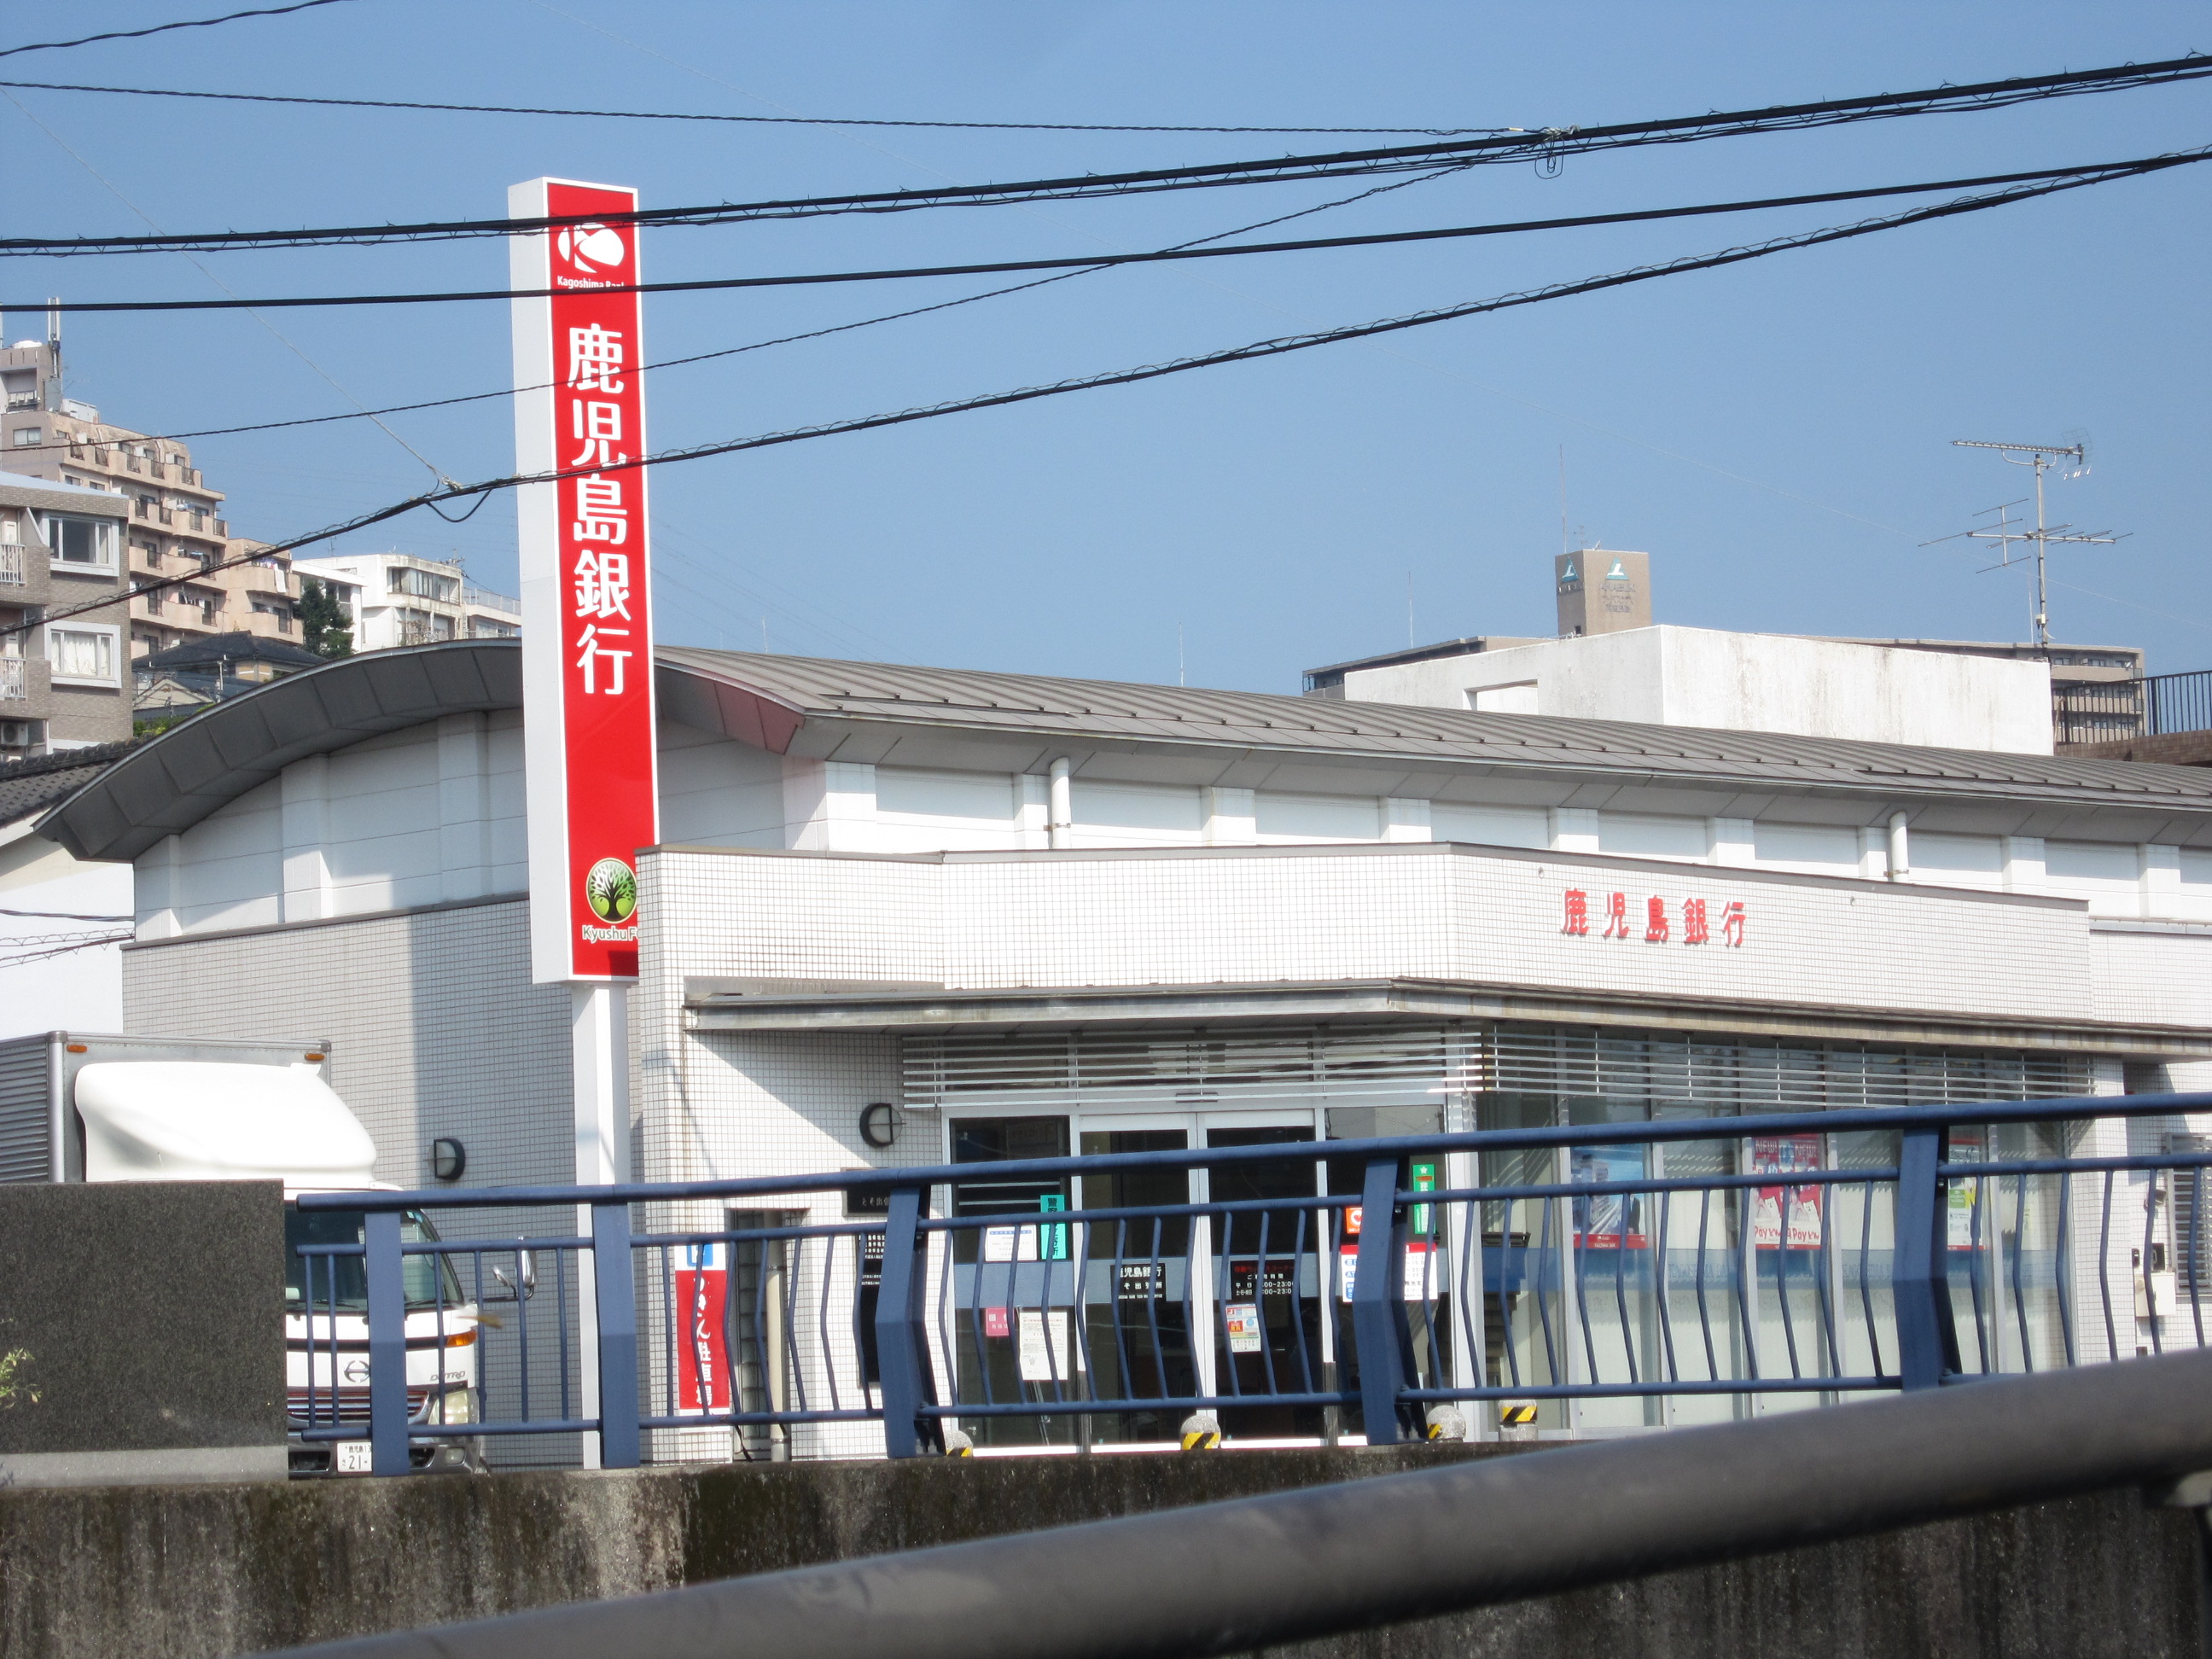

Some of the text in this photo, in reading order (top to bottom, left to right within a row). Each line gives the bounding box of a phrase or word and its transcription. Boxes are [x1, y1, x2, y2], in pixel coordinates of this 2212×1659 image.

[557, 275, 604, 289] Kagoshima
[567, 323, 632, 696] 鹿児島銀行
[1563, 888, 1746, 946] 鹿児島銀行
[582, 925, 626, 943] Kyushu
[430, 1371, 466, 1382] DTRO
[348, 1455, 368, 1470] 21-
